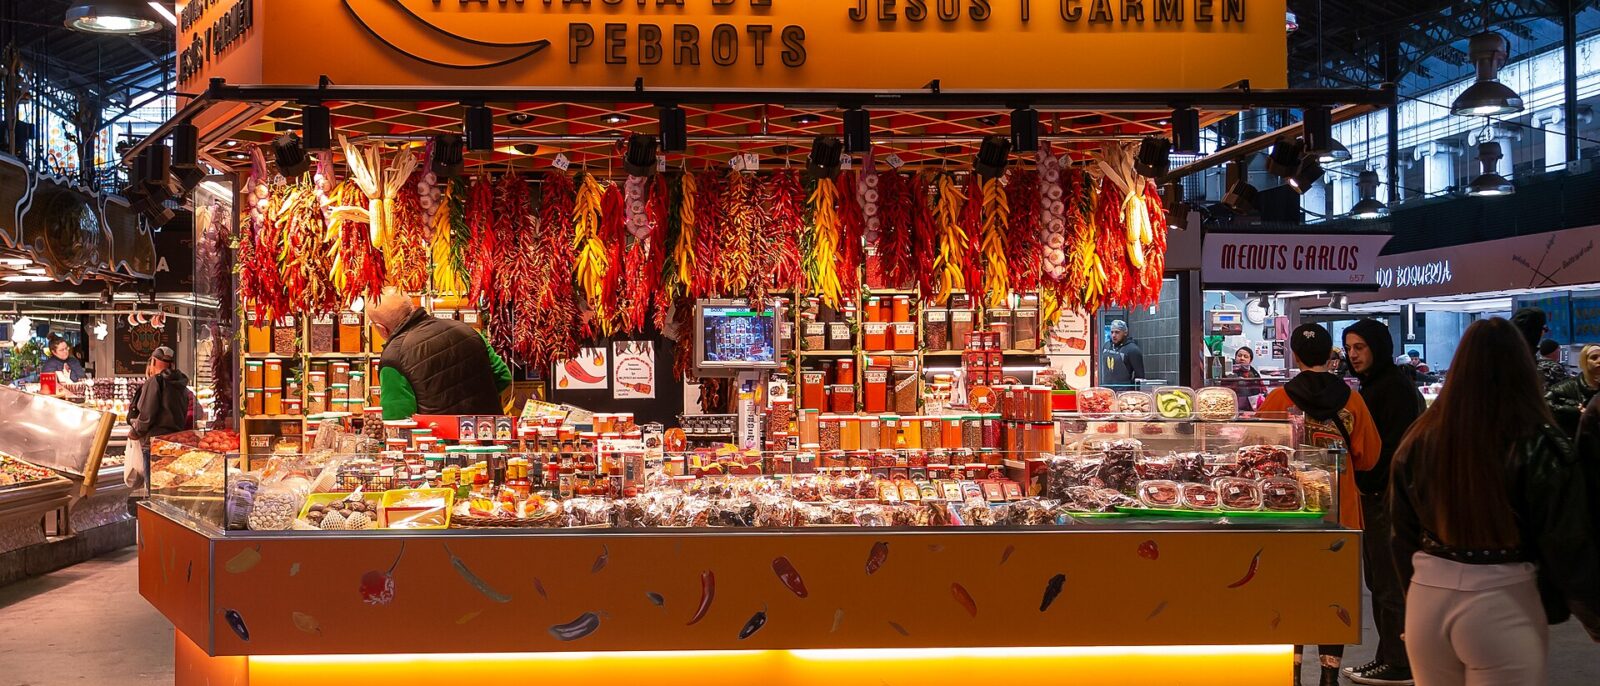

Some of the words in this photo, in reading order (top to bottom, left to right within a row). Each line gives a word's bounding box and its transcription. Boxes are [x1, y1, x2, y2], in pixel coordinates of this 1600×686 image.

[1059, 0, 1246, 23] CARMEN
[568, 22, 807, 68] PEBROTS
[1220, 243, 1288, 270] MENUTS
[1292, 245, 1359, 271] CARLOS
[1349, 273, 1365, 282] 657
[1396, 259, 1452, 288] BOQUERIA
